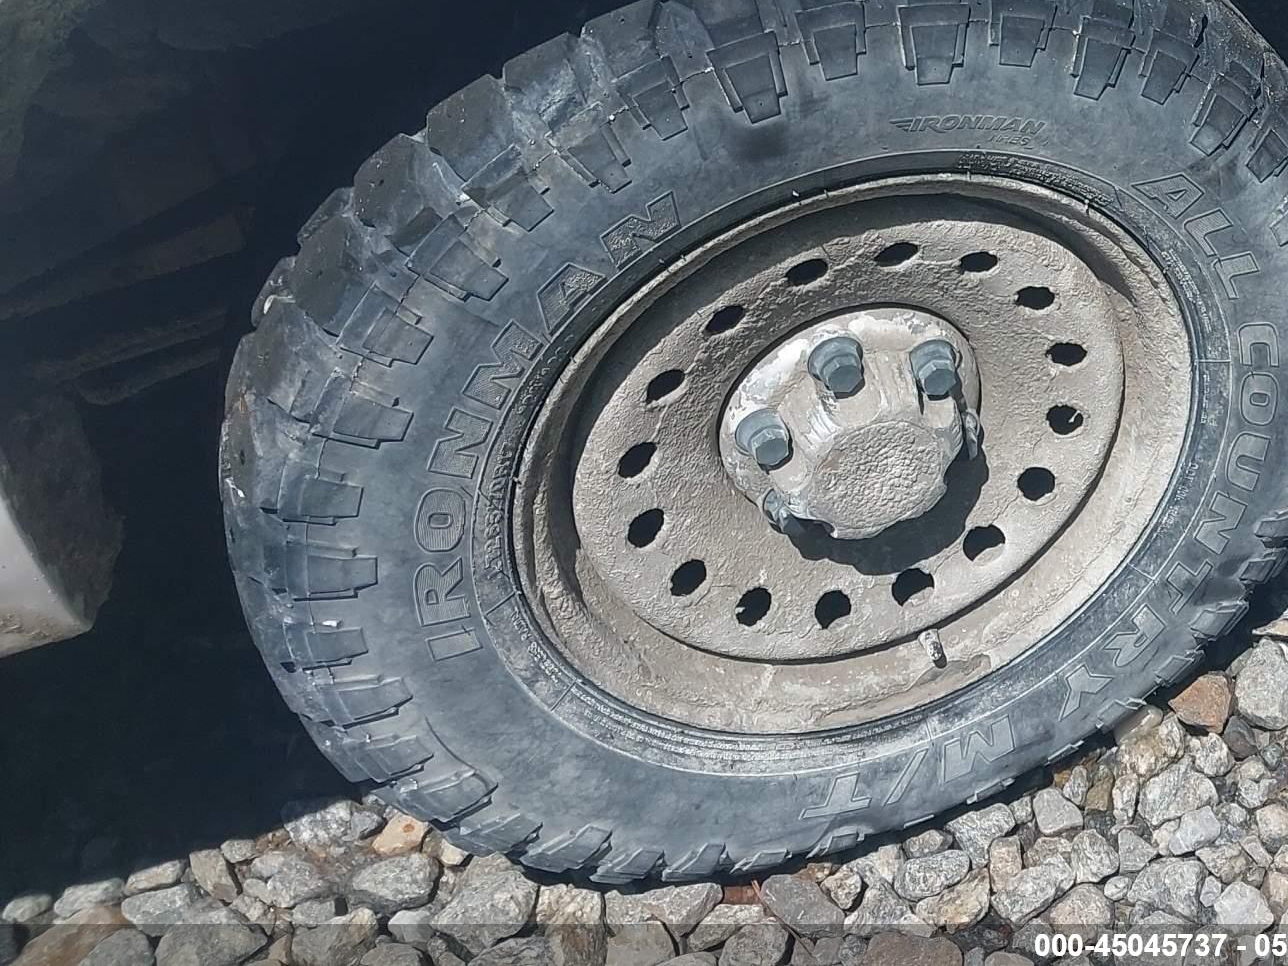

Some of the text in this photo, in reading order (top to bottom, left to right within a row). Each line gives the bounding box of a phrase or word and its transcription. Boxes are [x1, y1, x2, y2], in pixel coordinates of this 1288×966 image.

[908, 114, 1046, 135] IRONMAN
[414, 191, 681, 662] IRONMAN
[800, 173, 1280, 820] ALL COUNTRY M/T
